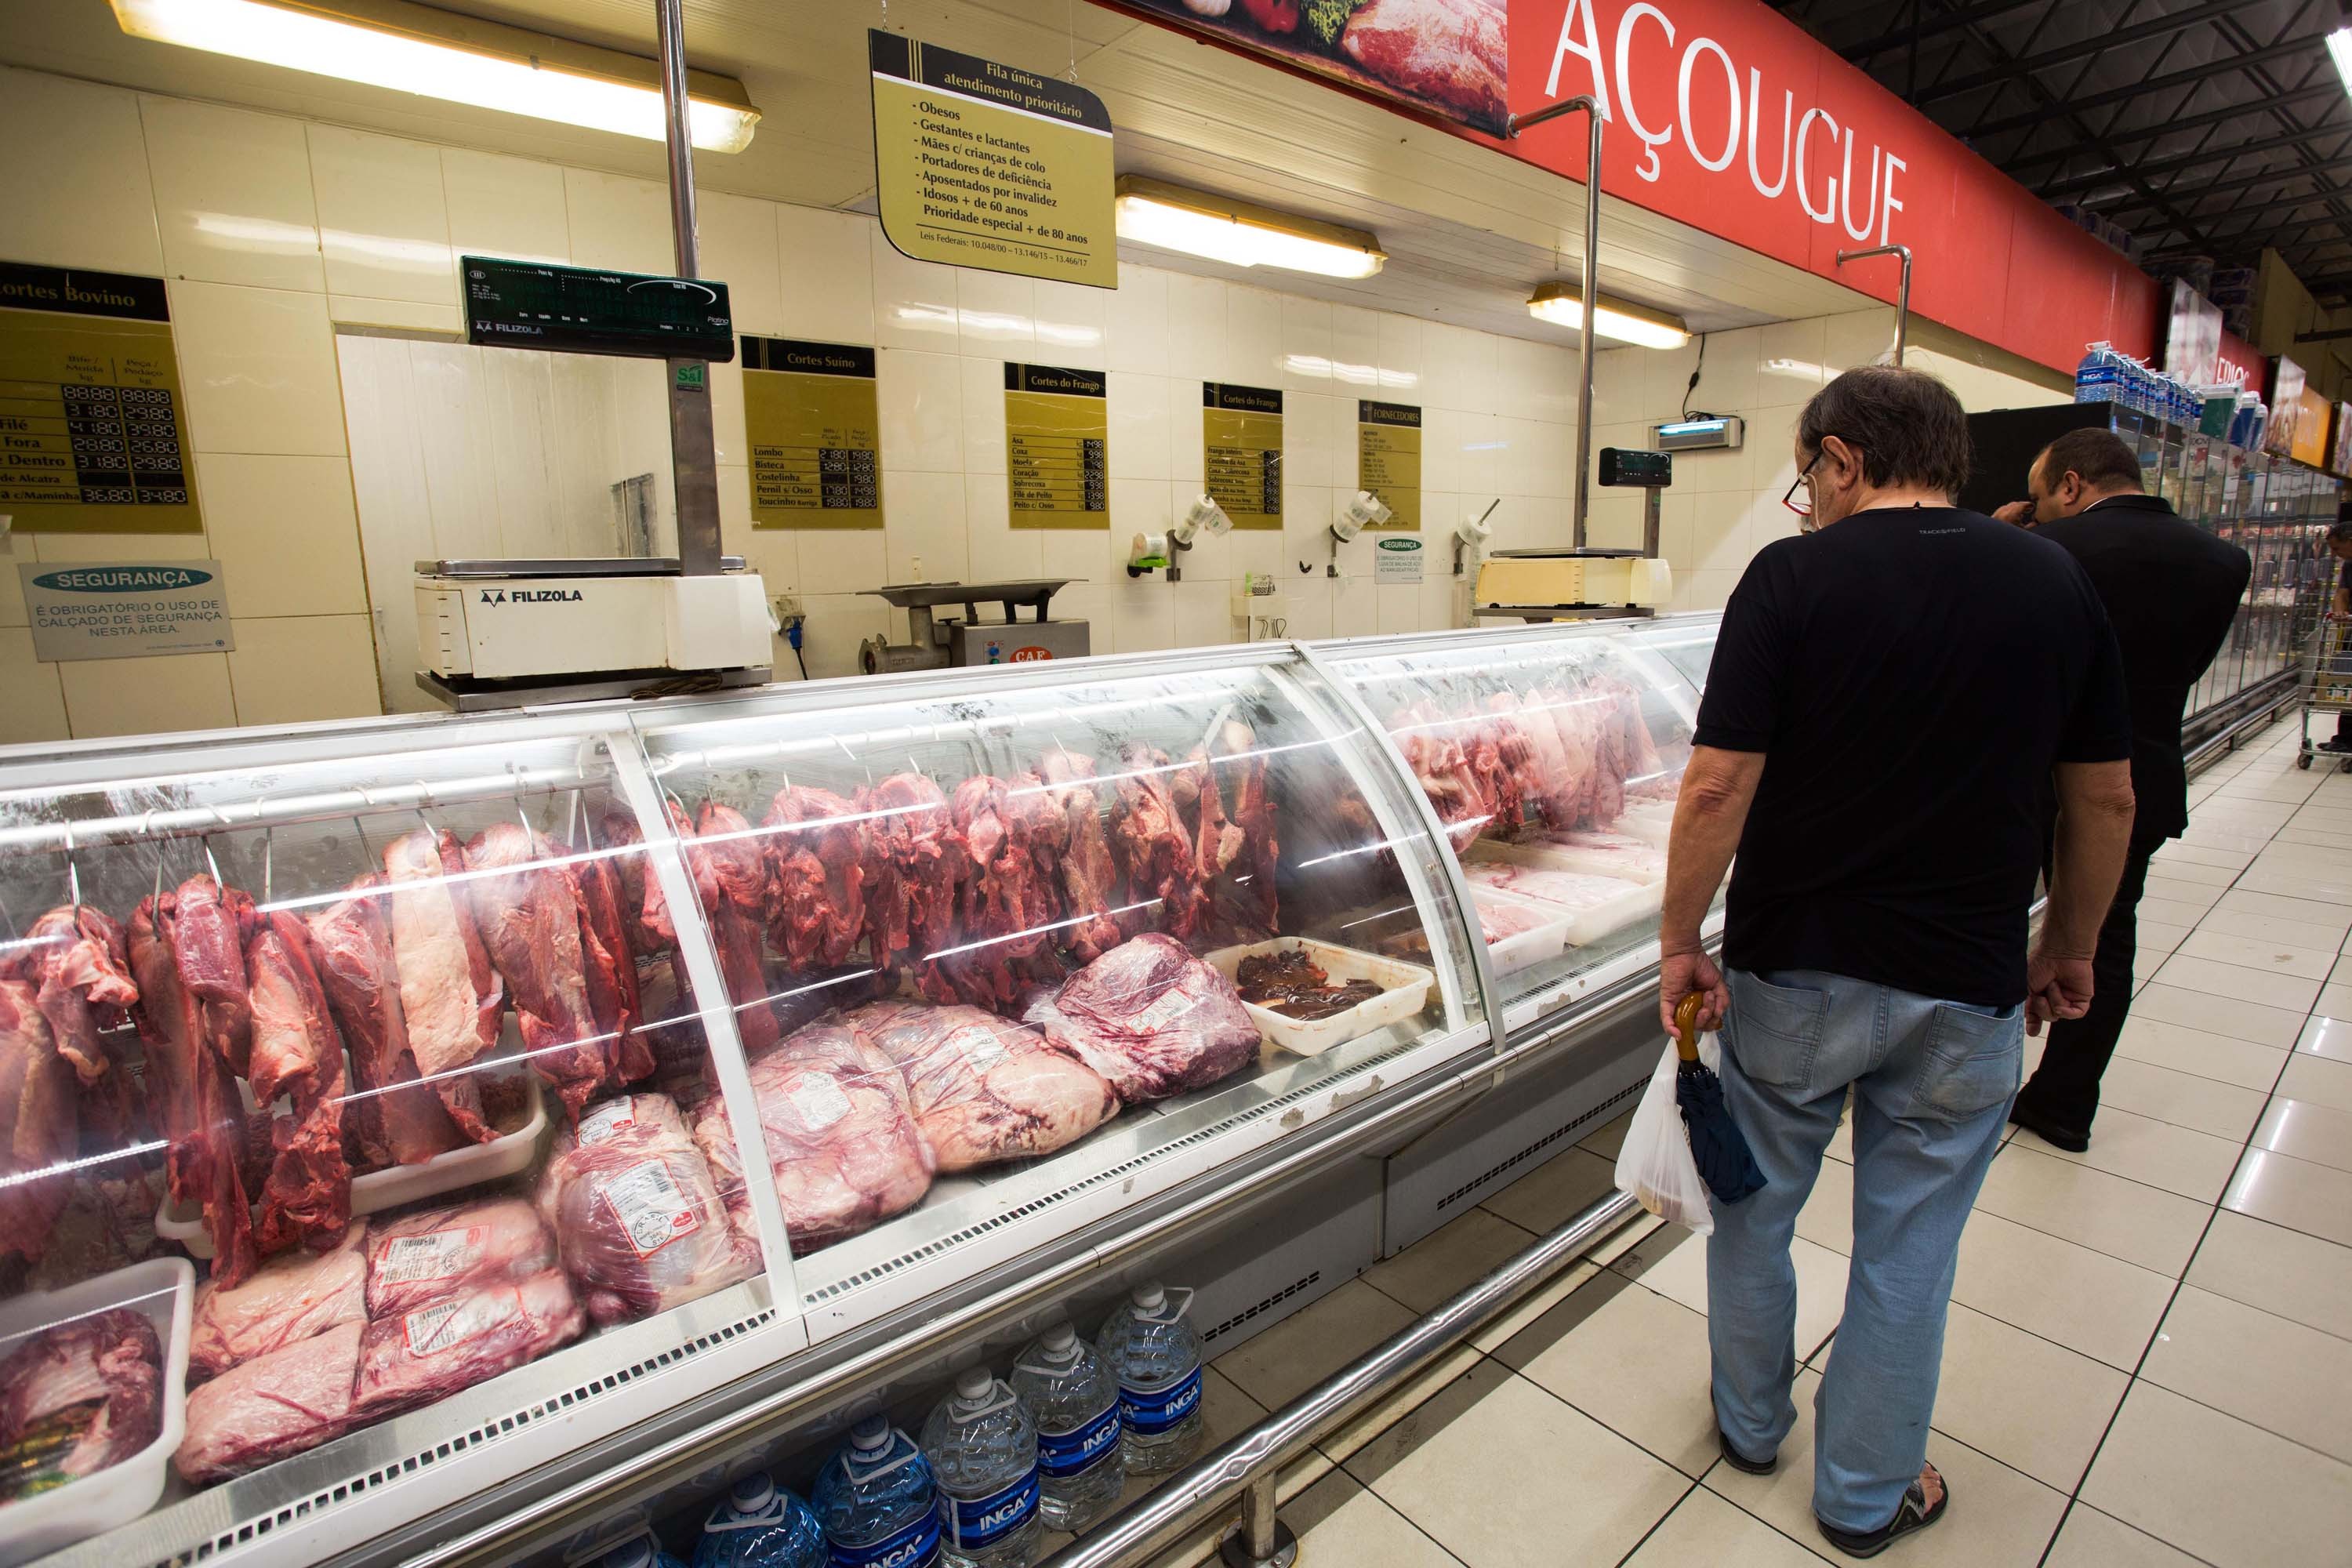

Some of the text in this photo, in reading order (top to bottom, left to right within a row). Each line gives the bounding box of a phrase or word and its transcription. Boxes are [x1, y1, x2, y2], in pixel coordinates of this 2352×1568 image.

[986, 63, 1043, 89] Fila única
[944, 71, 1082, 118] atendimento prioritário
[920, 101, 960, 121] Obesos
[1544, 0, 1907, 256] AÇOUGUE
[920, 118, 1030, 154] Gestantes e lactantes
[921, 136, 1046, 173] Mães c/ crianças de colo
[922, 153, 1051, 191] Portadores de deficiência
[922, 170, 1058, 208] Aposentados por invalidez
[924, 187, 958, 204] Idosos
[974, 197, 987, 209] de
[990, 201, 1003, 212] 60
[1005, 205, 1029, 217] anos
[924, 204, 979, 224] Prioridade
[982, 216, 1023, 232] especial
[1037, 225, 1050, 238] de
[1052, 228, 1064, 240] 80
[1066, 233, 1088, 245] anos
[920, 231, 935, 241] Leis
[936, 234, 969, 247] Federais:
[971, 240, 1007, 253] 10.048/00
[1014, 248, 1048, 260] 13.146/15
[66, 286, 136, 307] Bovino
[495, 324, 543, 335] FILIZOLA
[787, 353, 822, 366] Cortes
[1031, 376, 1100, 393] Cortes do Frango
[1224, 394, 1245, 405] Cortes
[1256, 397, 1278, 409] Frango
[1374, 409, 1420, 422] FORNECEDORES
[0, 418, 28, 430] Filé
[5, 436, 41, 449] Fora
[8, 454, 67, 466] Dentro
[753, 448, 783, 457] Lombo
[755, 460, 784, 470] Bisteca
[19, 474, 60, 484] Alcatra
[756, 473, 800, 482] Costelinha
[757, 485, 781, 495] Pernil
[792, 486, 813, 495] Osso
[757, 497, 797, 506] Toucinho
[1384, 541, 1417, 550] SEGURANÇA
[57, 572, 191, 587] SEGURANÇA
[512, 590, 583, 602] FILIZOLA
[36, 600, 220, 616] É OBRIGATÓRIO O USO DE
[38, 612, 222, 628] CALÇADO DE SEGURANÇA
[89, 624, 180, 637] NESTA ÁREA.
